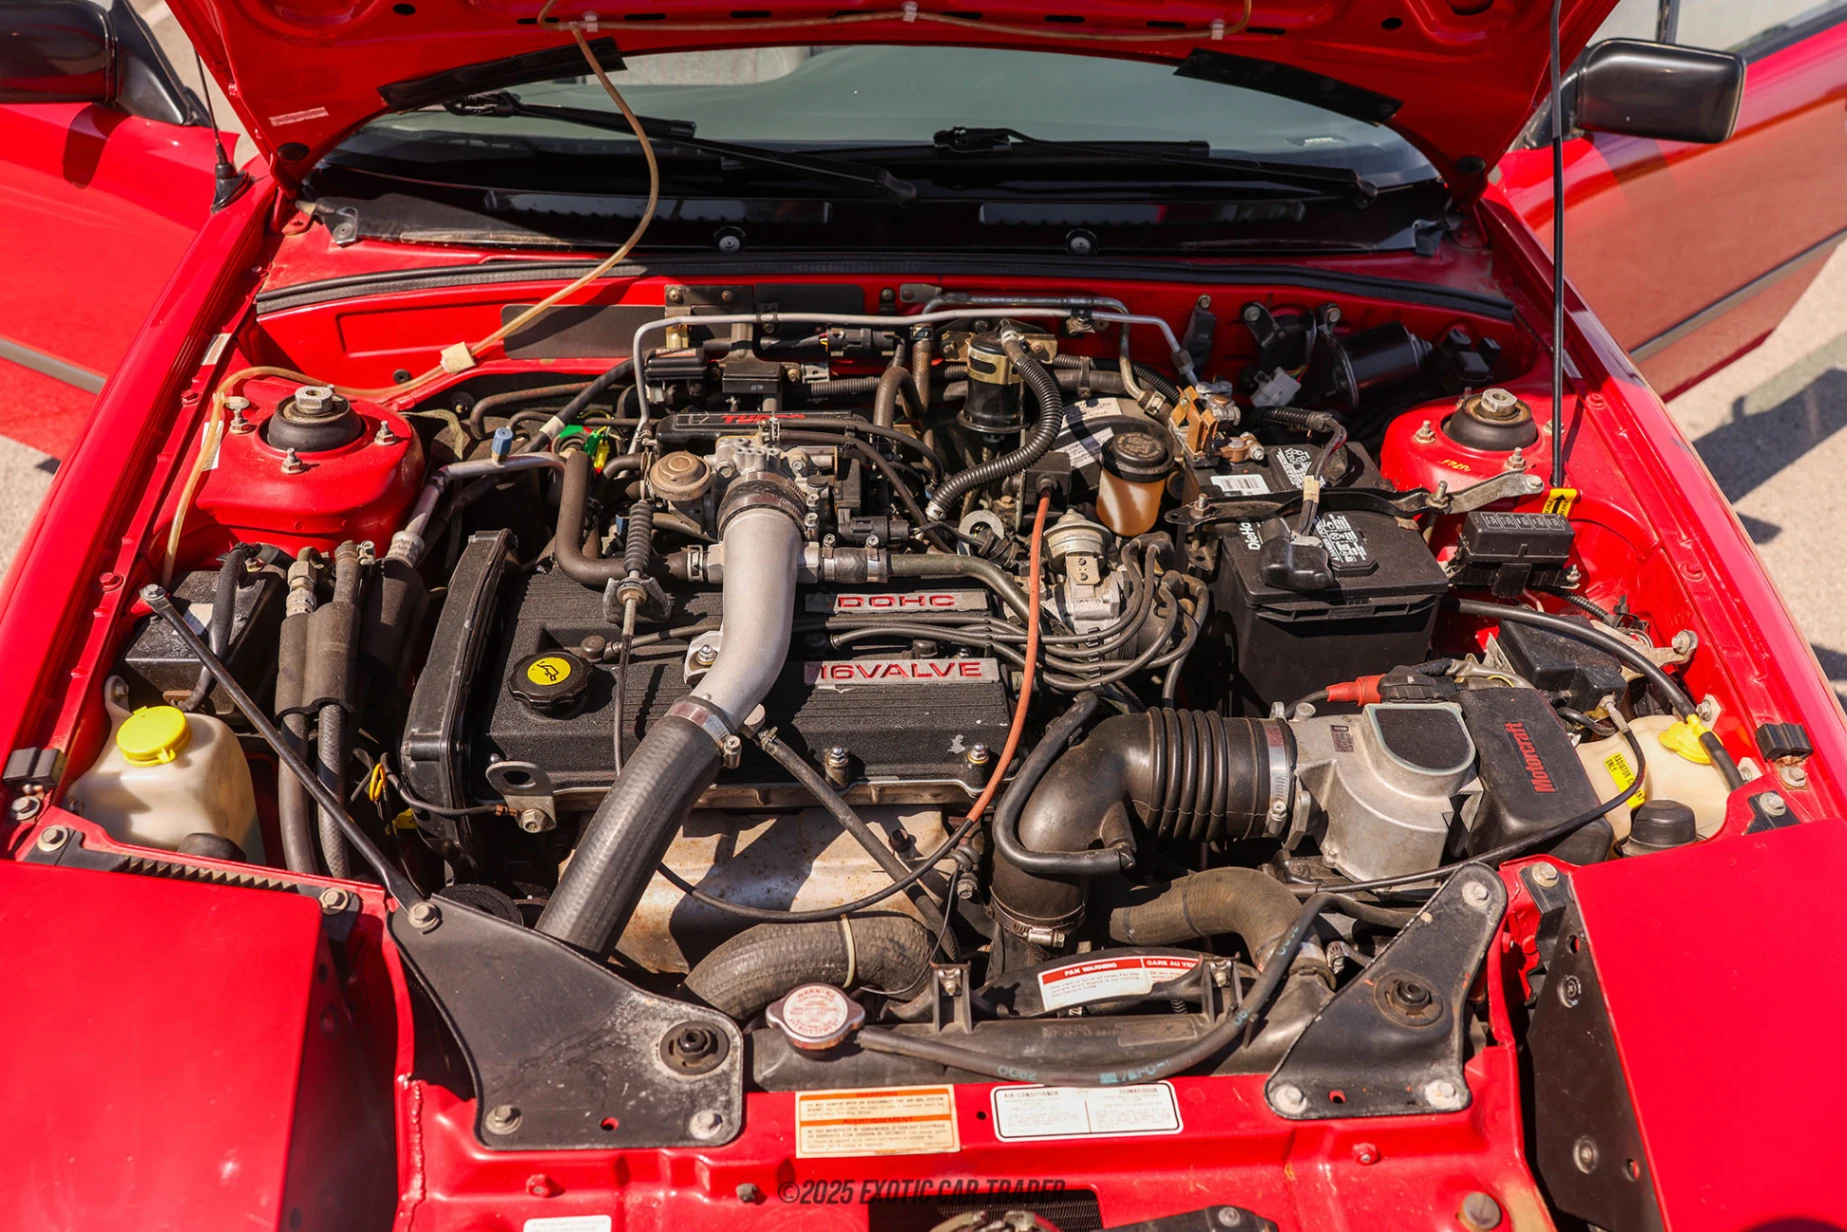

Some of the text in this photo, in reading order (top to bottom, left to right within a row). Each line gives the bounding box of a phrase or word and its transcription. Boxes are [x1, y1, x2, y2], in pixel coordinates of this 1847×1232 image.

[837, 594, 955, 608] DOHC
[1504, 721, 1556, 794] Motorcraft
[1605, 758, 1617, 772] ONLY
[1612, 753, 1632, 778] RADIATOR
[1064, 962, 1118, 977] FAN WARNING
